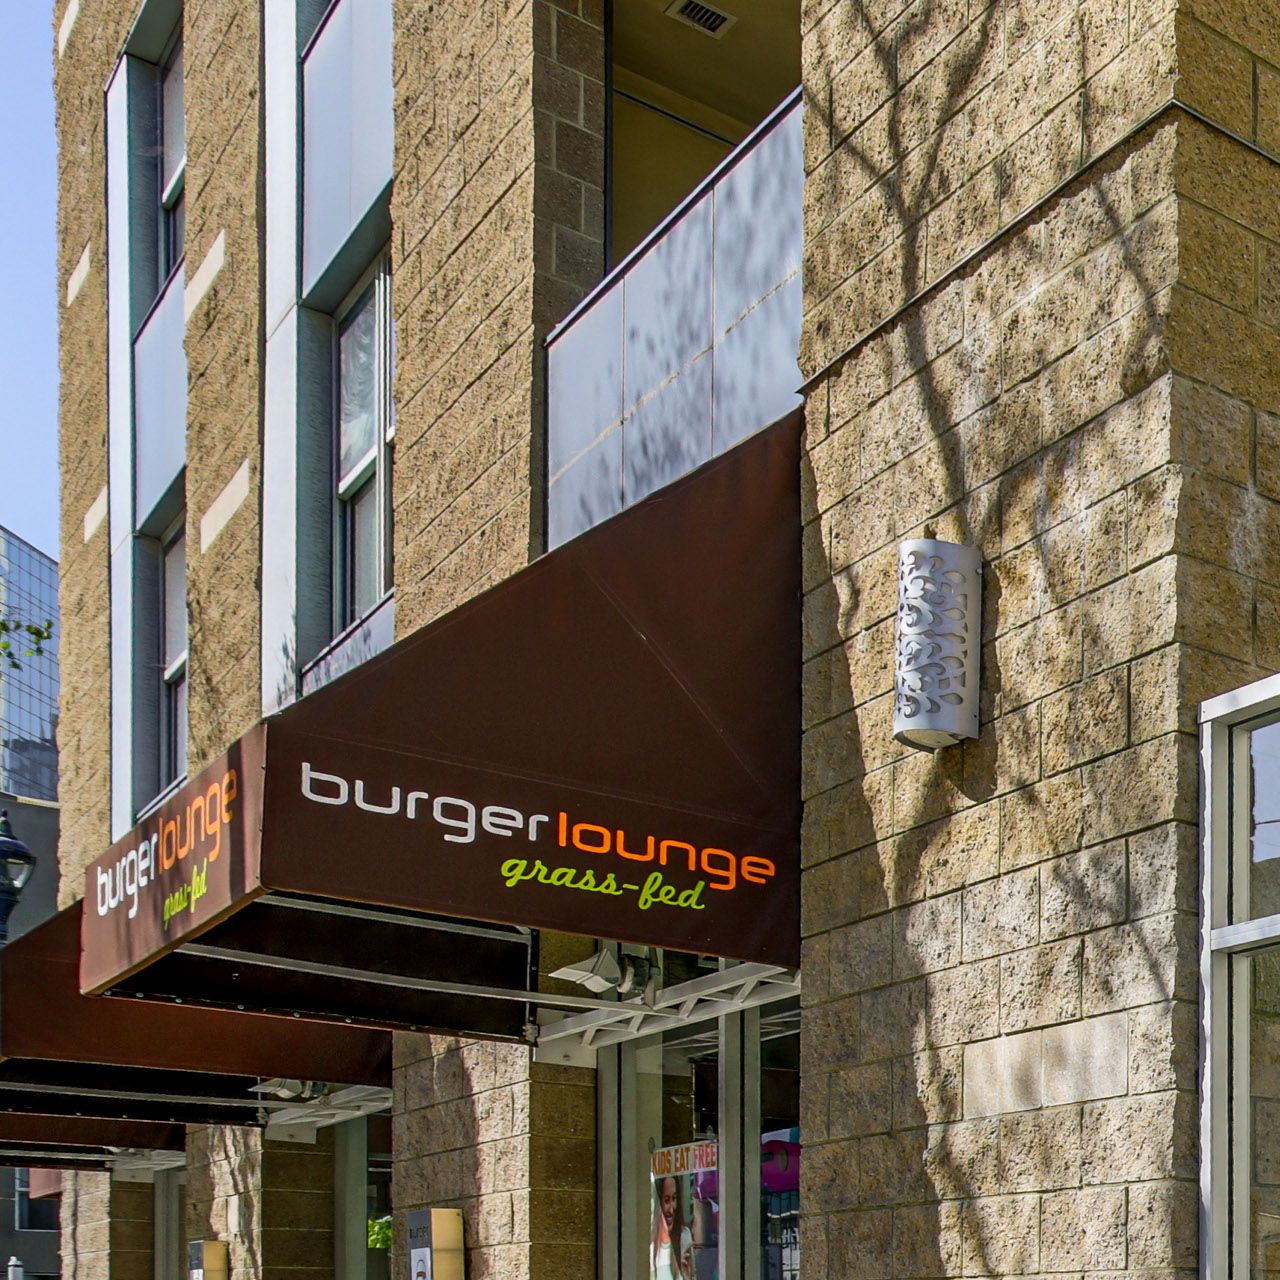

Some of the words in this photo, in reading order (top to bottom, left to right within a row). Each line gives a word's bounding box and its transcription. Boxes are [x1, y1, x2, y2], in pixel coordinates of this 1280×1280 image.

[97, 833, 158, 919] burger
[158, 768, 237, 875] lounge
[301, 762, 549, 844] burger
[557, 811, 776, 891] lounge
[500, 857, 706, 910] grass-fed
[652, 1150, 671, 1175] KIDS
[674, 1147, 690, 1171] EAT
[694, 1143, 717, 1169] FREE
